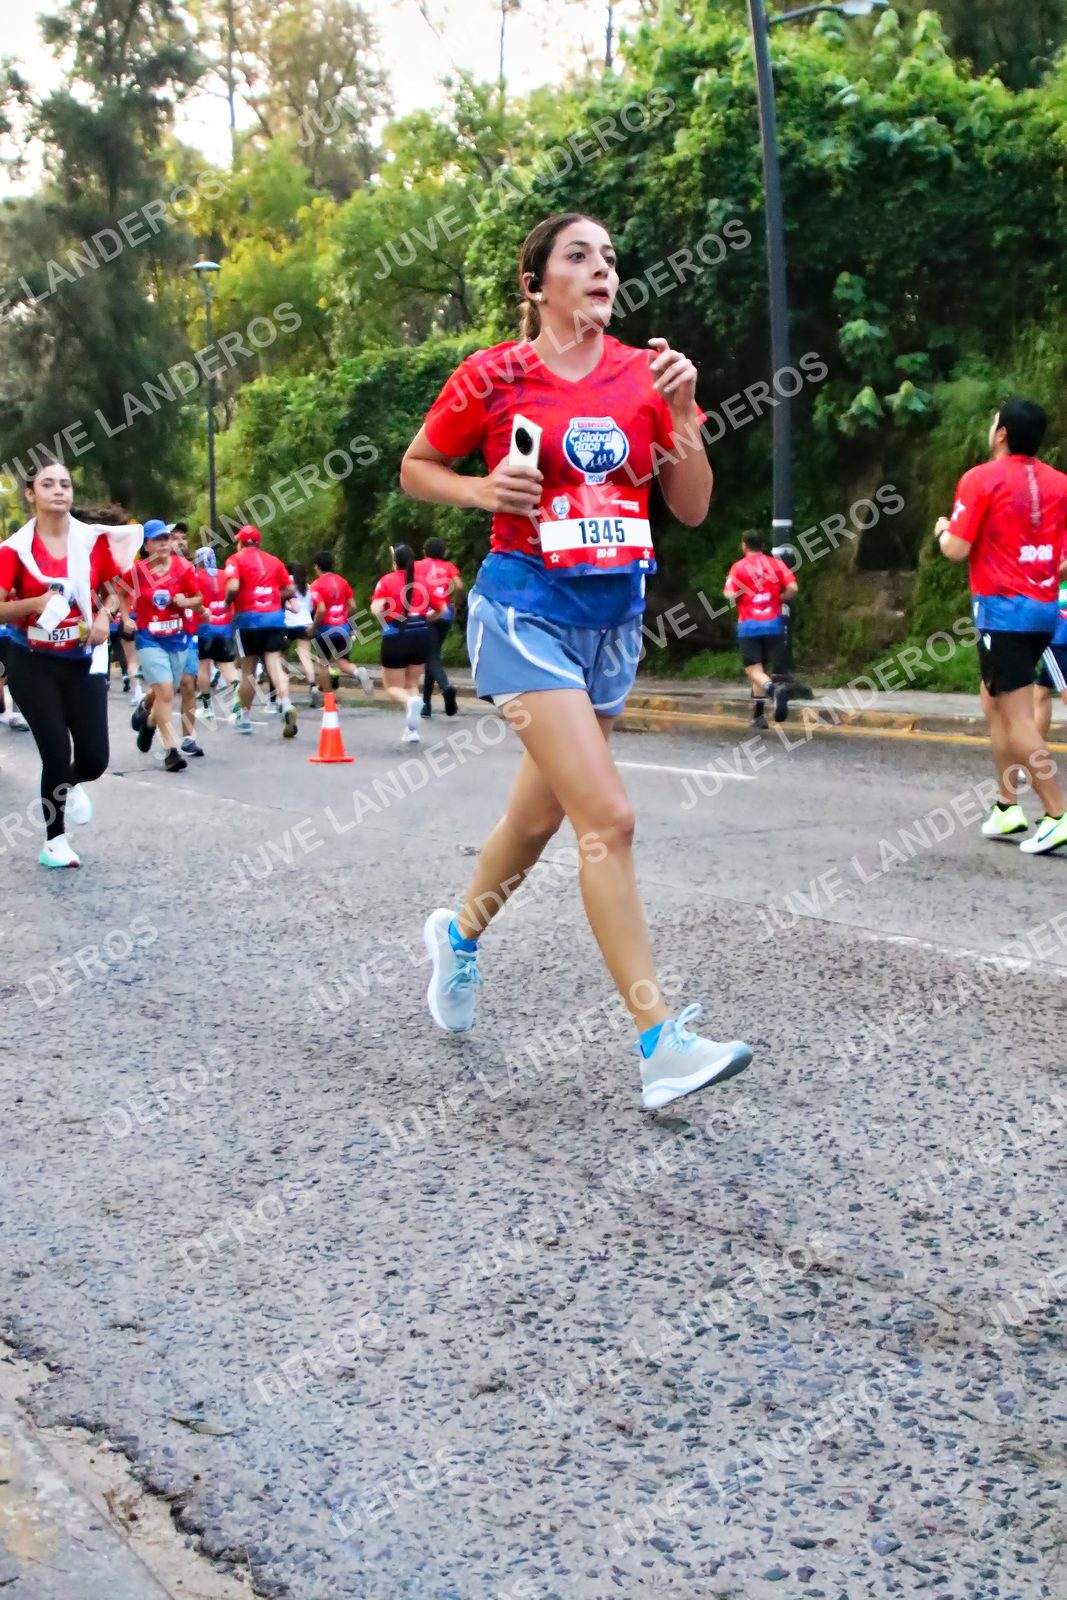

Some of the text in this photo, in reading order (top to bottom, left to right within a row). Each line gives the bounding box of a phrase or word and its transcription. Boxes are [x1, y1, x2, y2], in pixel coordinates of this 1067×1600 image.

[580, 432, 612, 442] Global
[574, 441, 601, 451] Race
[579, 520, 625, 544] 1345
